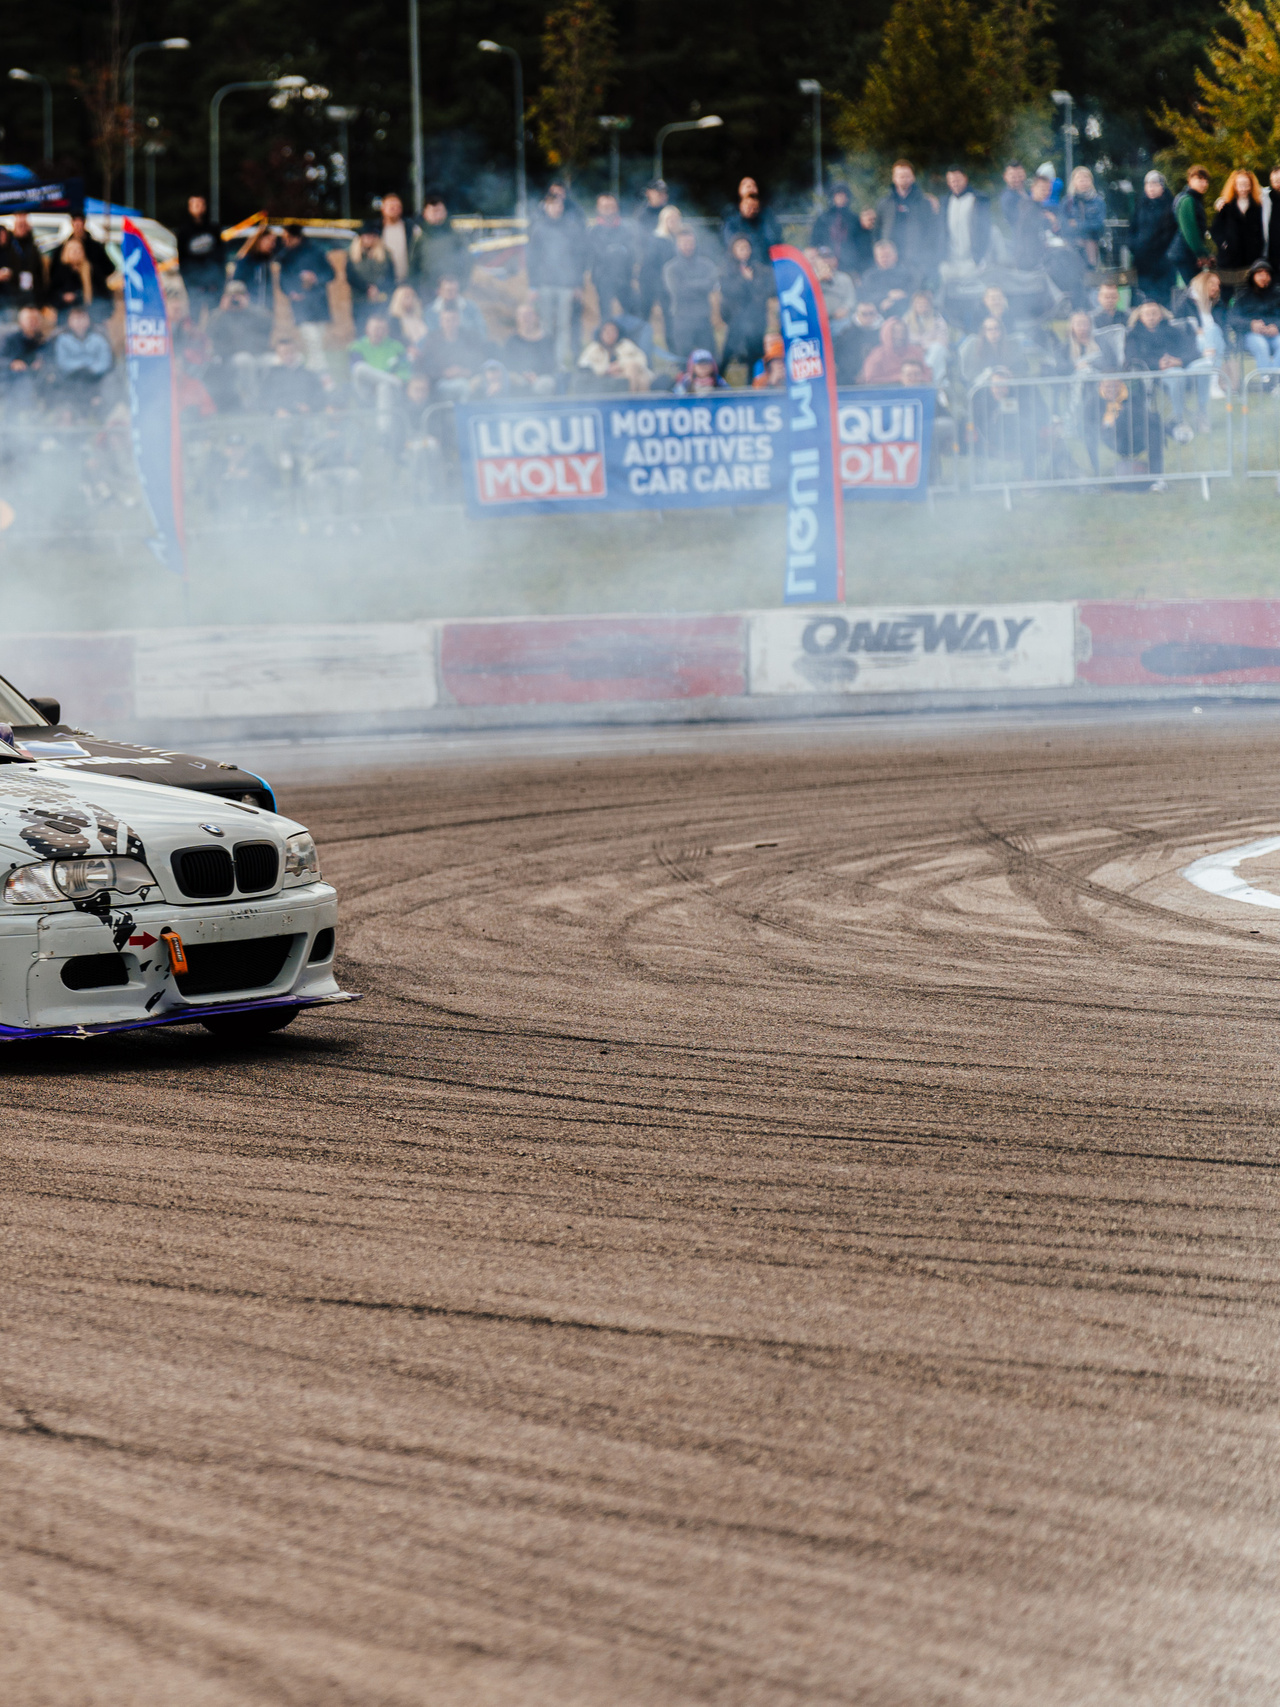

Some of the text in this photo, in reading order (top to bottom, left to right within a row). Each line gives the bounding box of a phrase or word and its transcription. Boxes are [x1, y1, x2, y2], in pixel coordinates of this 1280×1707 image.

[477, 415, 595, 456] LIQUI
[611, 406, 783, 438] MOTOR OILS
[838, 404, 916, 443] QUI
[623, 434, 775, 467] ADDITIVES
[840, 443, 918, 482] OLY
[483, 454, 600, 499] MOLY
[629, 464, 771, 495] CAR CARE
